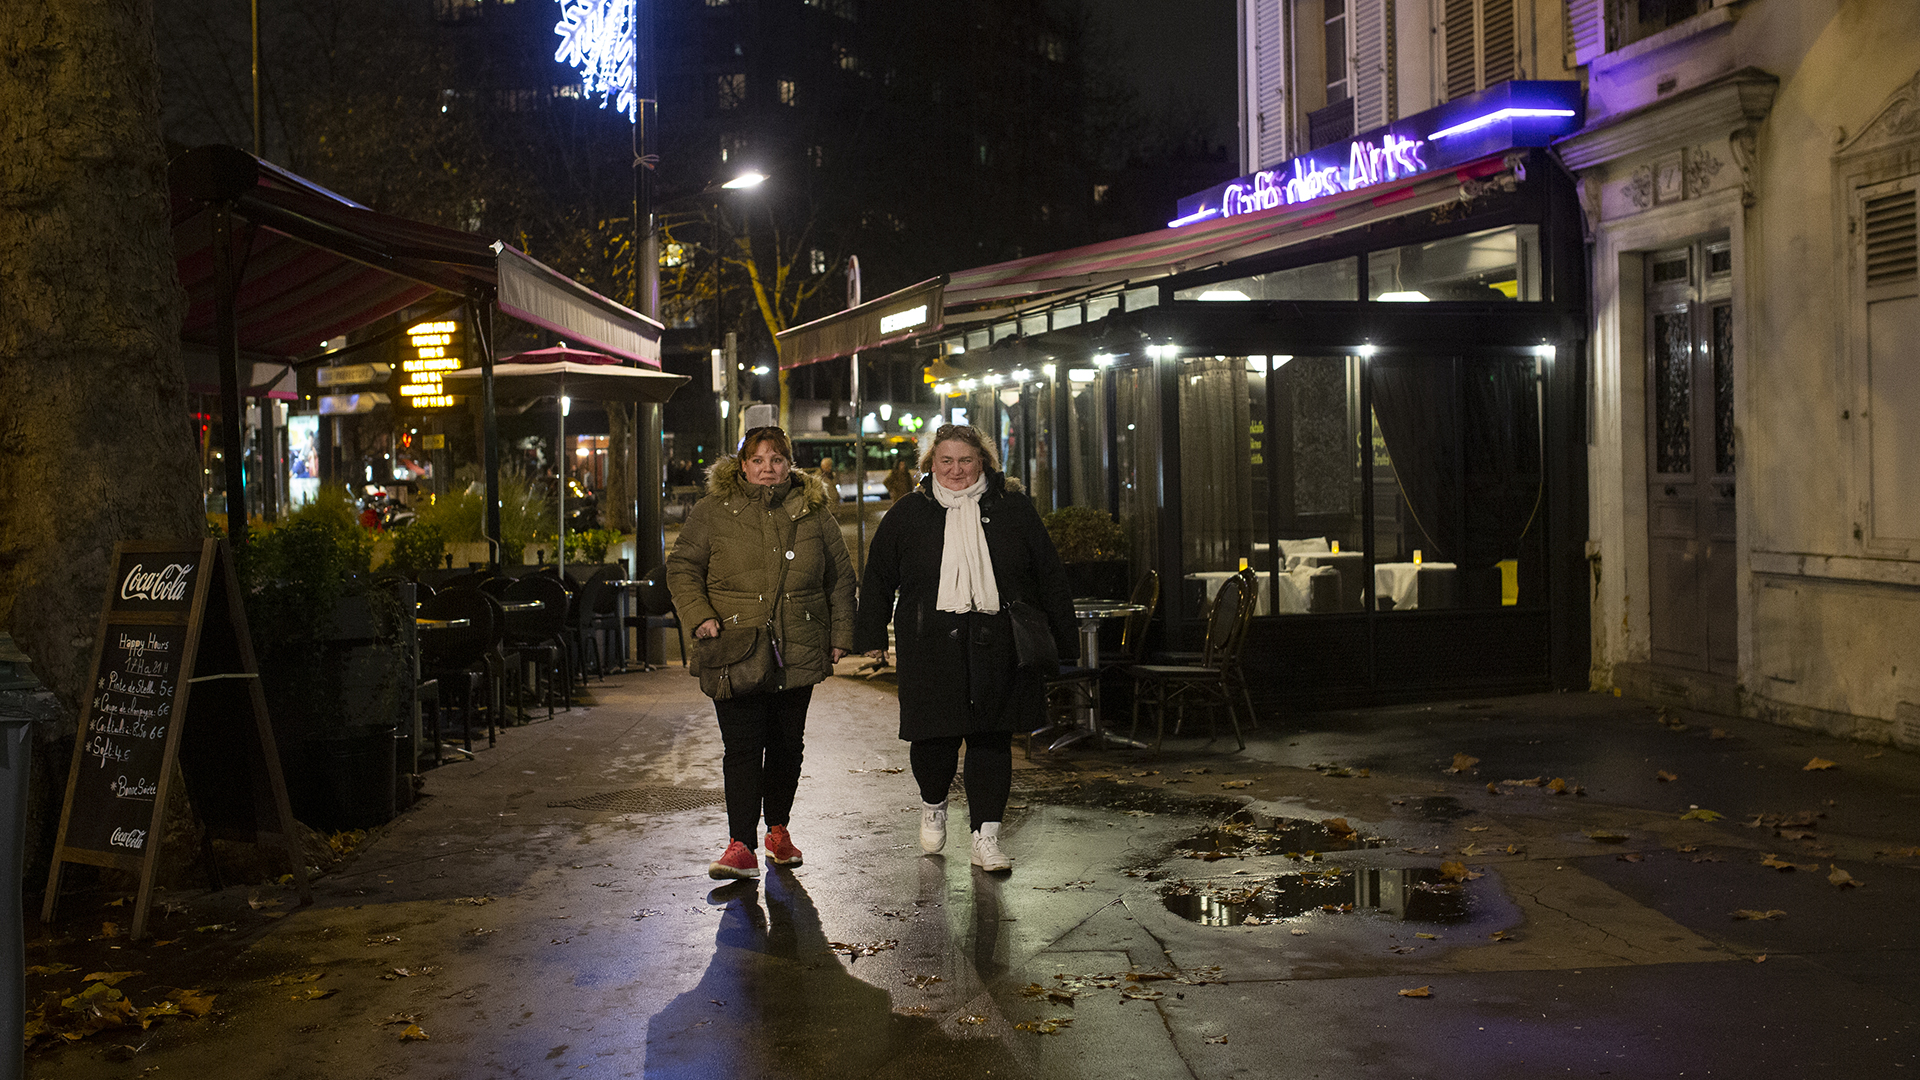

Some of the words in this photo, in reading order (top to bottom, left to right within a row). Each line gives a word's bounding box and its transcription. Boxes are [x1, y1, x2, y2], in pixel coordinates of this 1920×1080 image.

[1348, 135, 1419, 191] Arts
[121, 563, 195, 601] Coca-Cola
[119, 633, 145, 657] Happy
[147, 632, 169, 650] Hours
